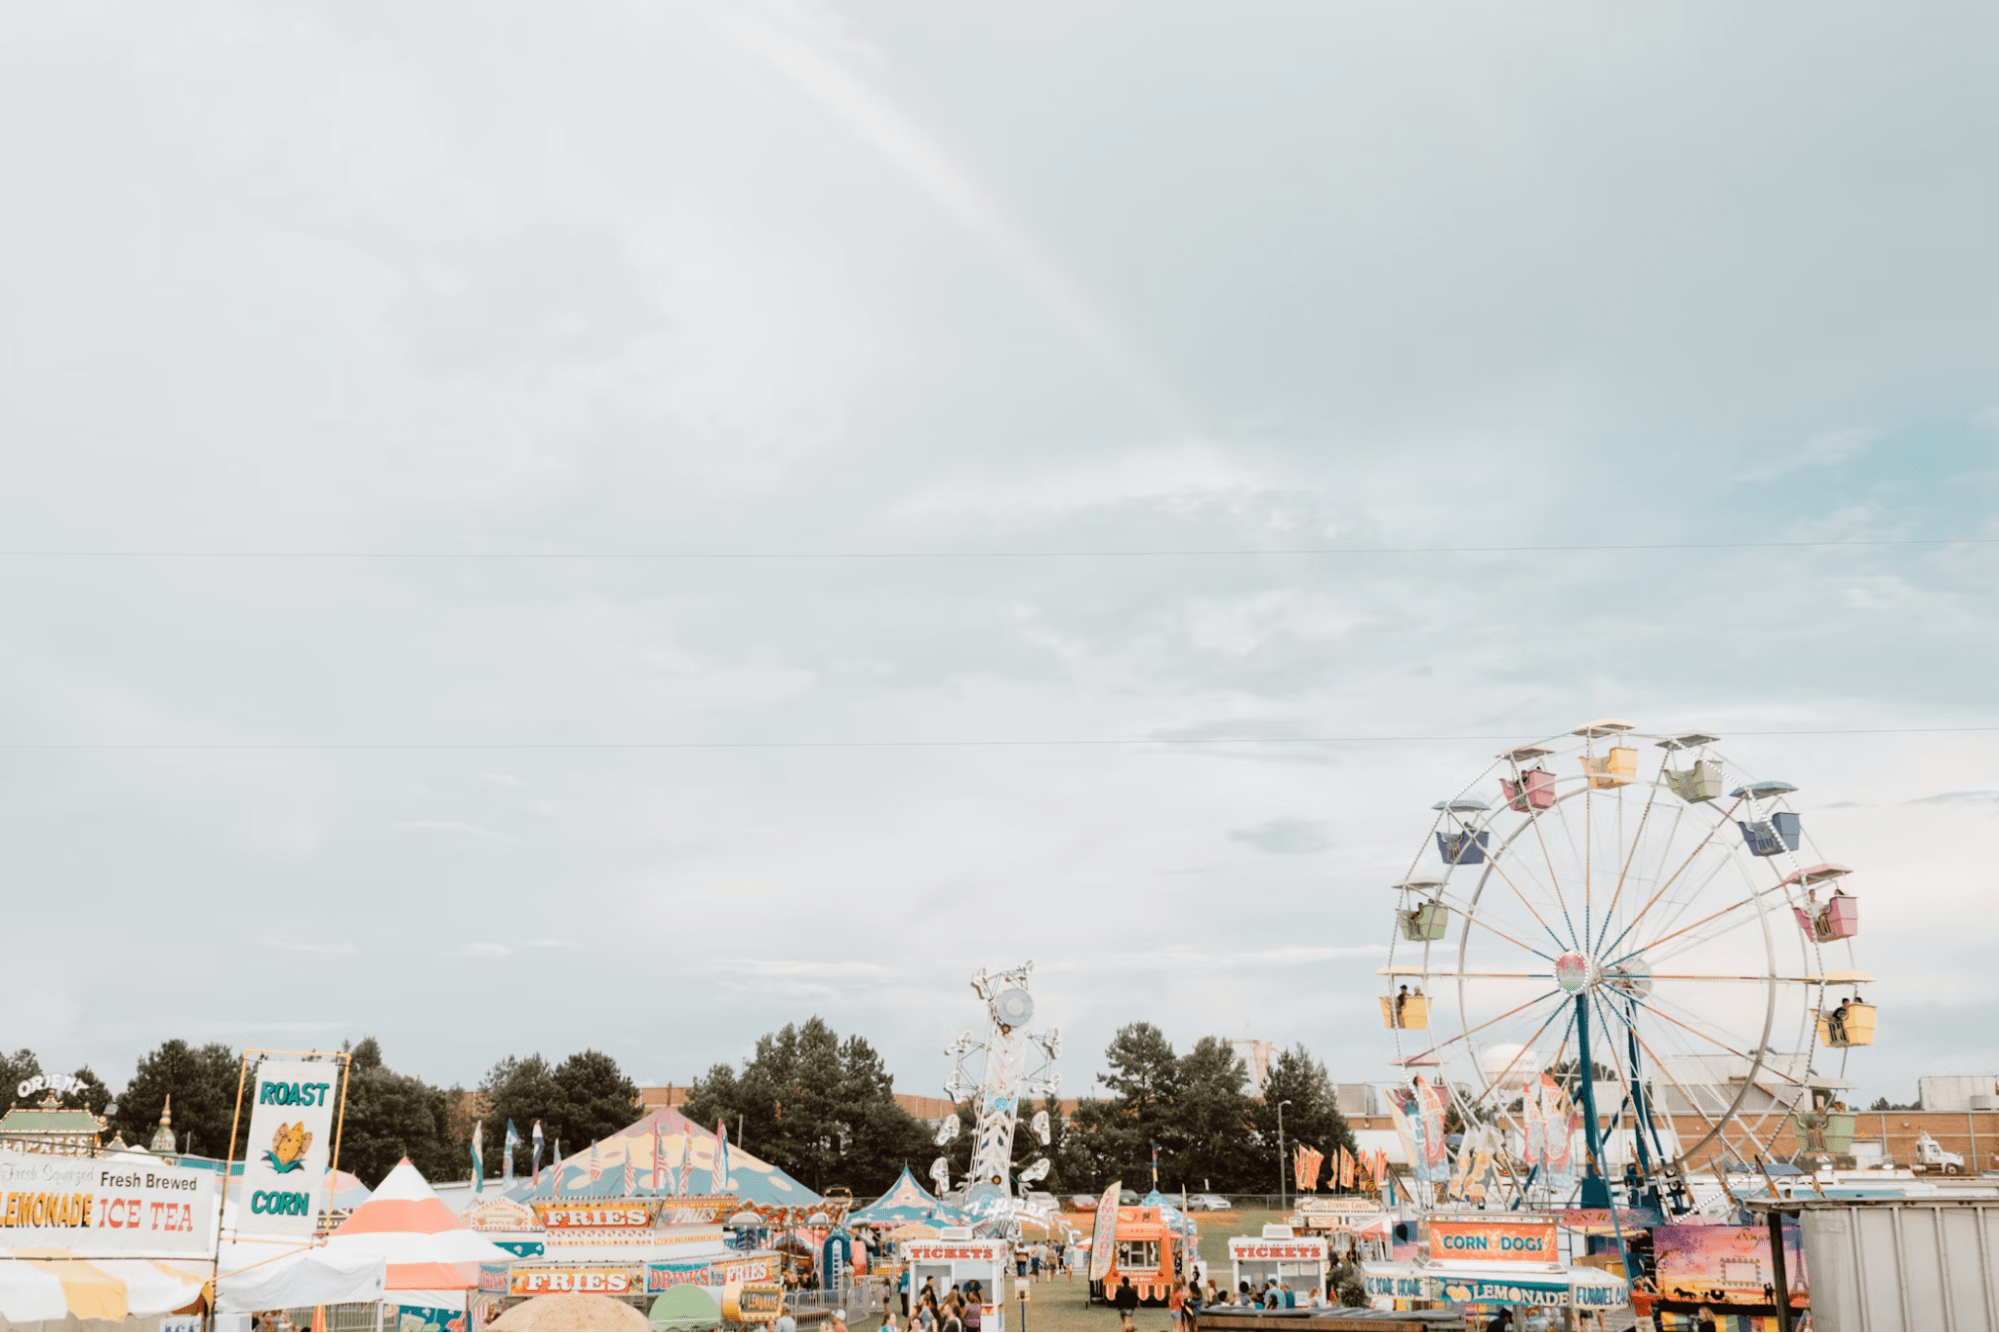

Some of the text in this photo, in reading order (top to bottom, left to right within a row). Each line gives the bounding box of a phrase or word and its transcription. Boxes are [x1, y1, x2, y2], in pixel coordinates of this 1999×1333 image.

[17, 1074, 90, 1098] ORIENT
[259, 1081, 330, 1106] ROAST
[2, 1162, 95, 1187] Fresh Squeezed
[100, 1171, 197, 1191] Fresh Brewed
[250, 1190, 310, 1216] CORN
[98, 1197, 194, 1232] ICE TEA
[547, 1209, 647, 1226] FRIES
[672, 1206, 719, 1225] FRIES
[1098, 1189, 1115, 1259] LEMONADE
[911, 1249, 993, 1259] TICKETS
[1235, 1247, 1321, 1258] TICKETS
[1442, 1235, 1543, 1251] CORN DOGS
[526, 1273, 627, 1291] FRIES
[650, 1267, 709, 1290] DRINKS
[726, 1262, 767, 1285] FRIES
[1473, 1284, 1569, 1306] LEMONADE
[1576, 1286, 1614, 1305] FUNNEL
